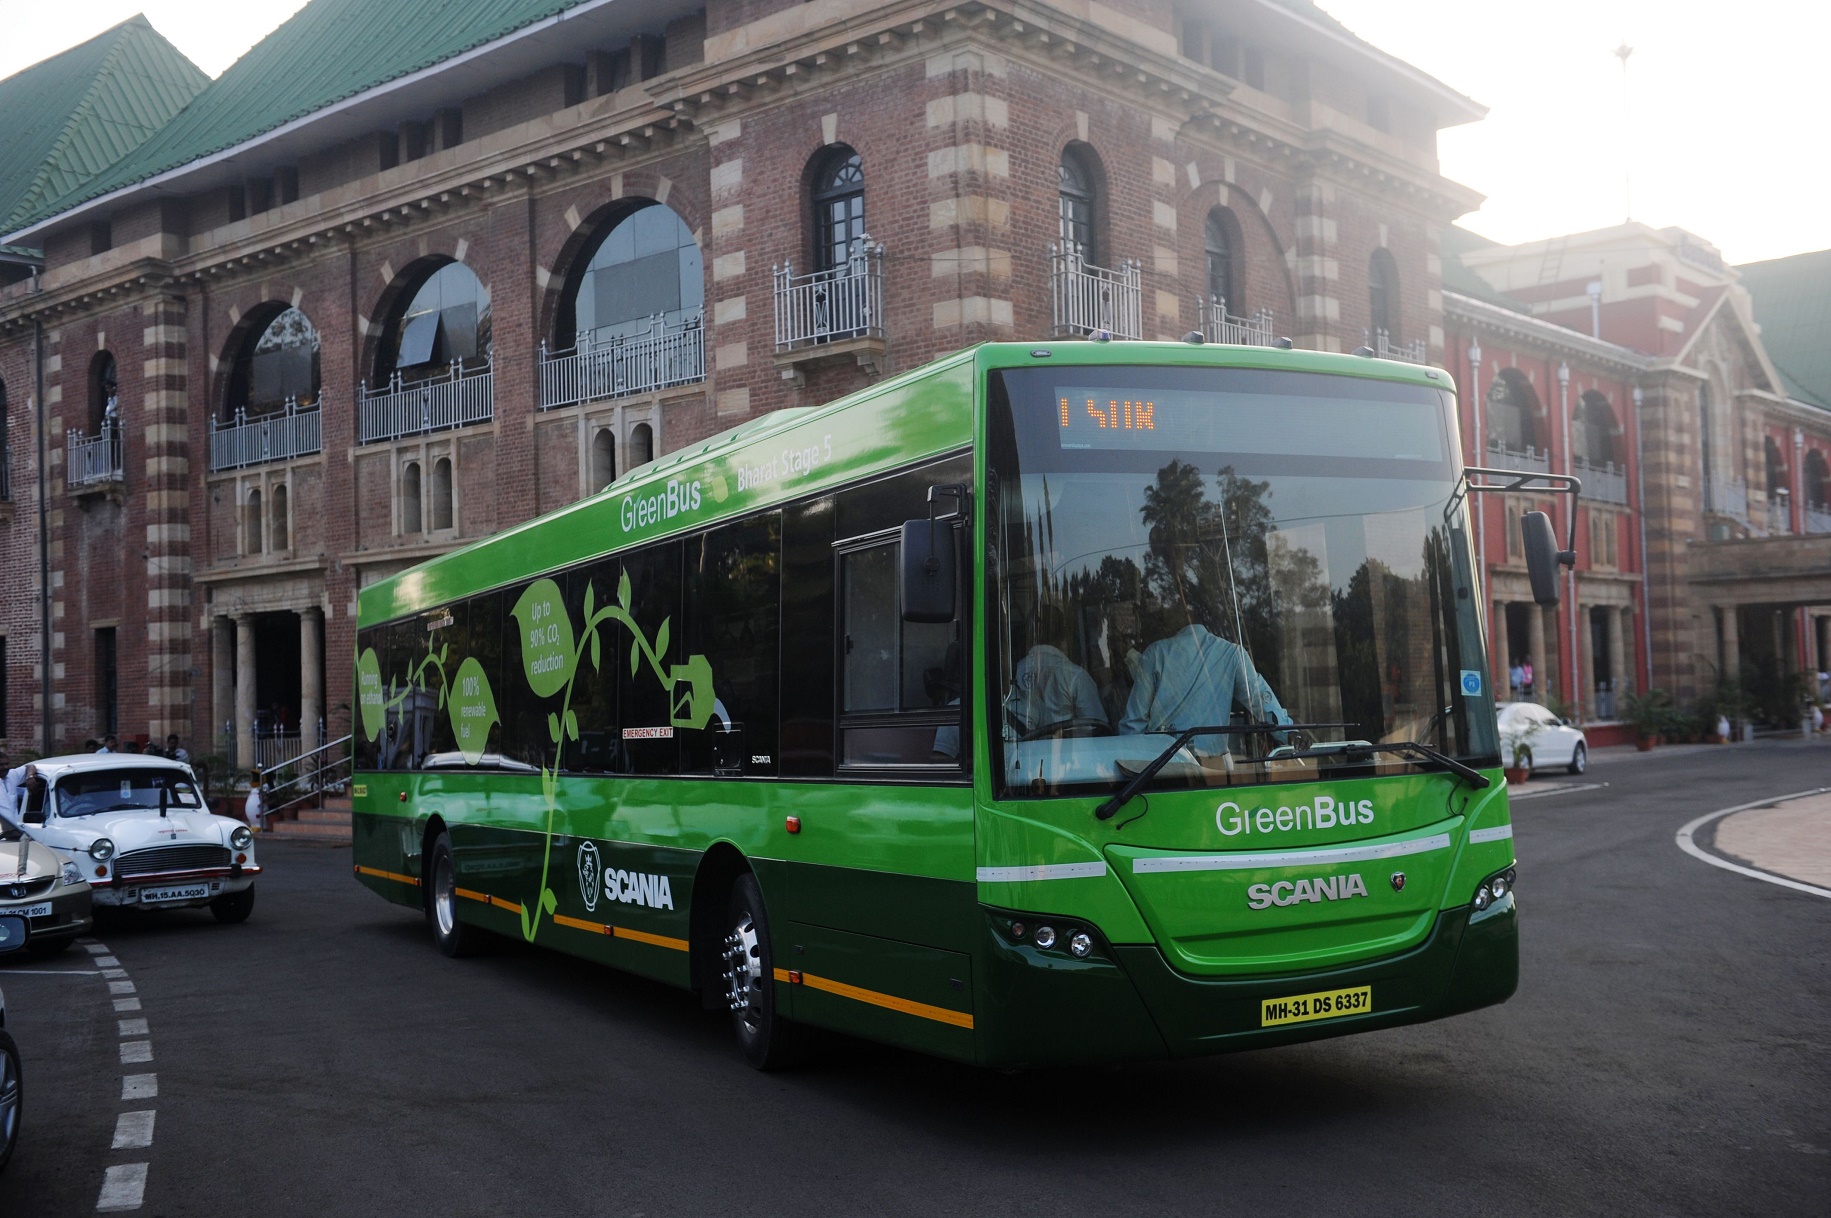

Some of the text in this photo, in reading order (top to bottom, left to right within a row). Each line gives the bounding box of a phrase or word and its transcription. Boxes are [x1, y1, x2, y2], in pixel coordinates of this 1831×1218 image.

[737, 434, 832, 493] Bharat Stage 5
[621, 479, 701, 533] GreenBus
[531, 601, 551, 624] Up to
[530, 627, 545, 648] 90%
[531, 651, 564, 675] reduction
[462, 676, 480, 697] 100%
[461, 702, 486, 717] renewable
[460, 723, 471, 738] fuel
[623, 727, 673, 738] EMERGENCY EXIT
[752, 755, 771, 764] SCANIA
[1216, 796, 1375, 836] GreenBus
[604, 867, 674, 910] SCANIA
[1247, 873, 1368, 910] SCANIA
[31, 907, 47, 915] 1001
[1265, 991, 1368, 1021] MH-31 DS 6337
